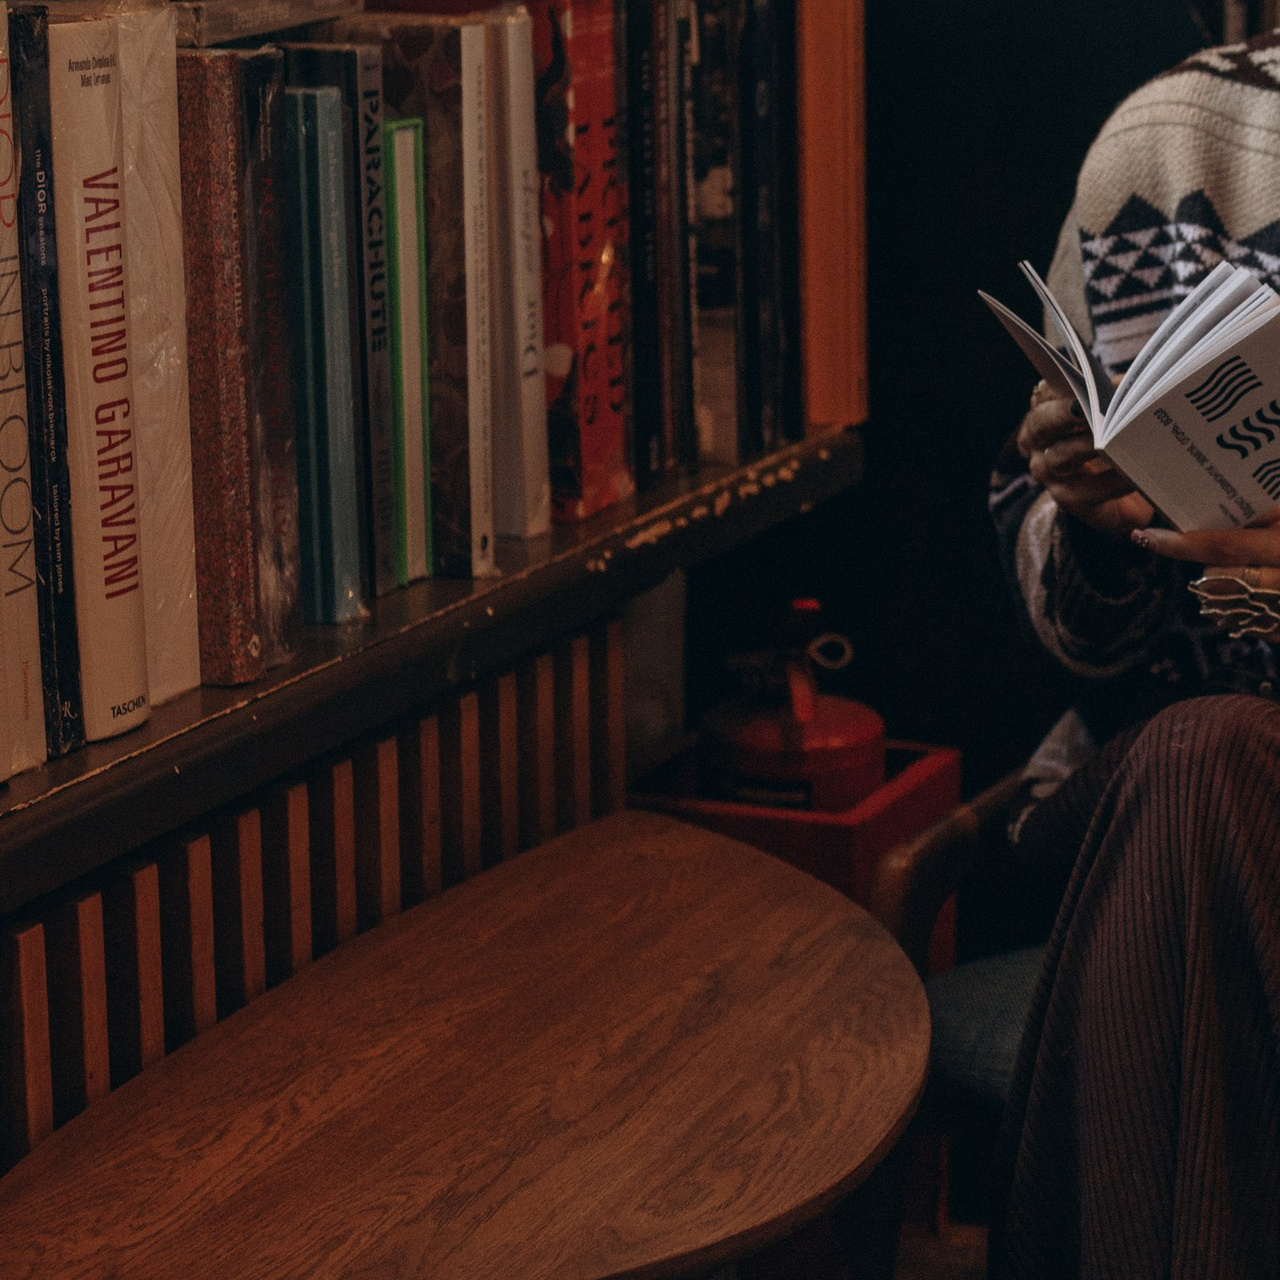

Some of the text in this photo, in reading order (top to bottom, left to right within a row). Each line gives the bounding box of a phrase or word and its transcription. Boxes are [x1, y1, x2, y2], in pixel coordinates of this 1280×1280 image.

[35, 149, 43, 168] the
[36, 171, 47, 214] DIOR
[38, 217, 47, 266] sessions
[362, 88, 388, 353] PARACHUTE
[41, 288, 51, 336] portraits
[43, 338, 51, 351] by
[83, 167, 139, 600] VALENTINO GARAVANI
[48, 413, 57, 463] bismarck
[52, 484, 61, 526] tailored
[53, 527, 61, 540] by
[55, 543, 63, 562] kim
[55, 564, 64, 594] jones
[110, 693, 146, 718] TASCHEN
